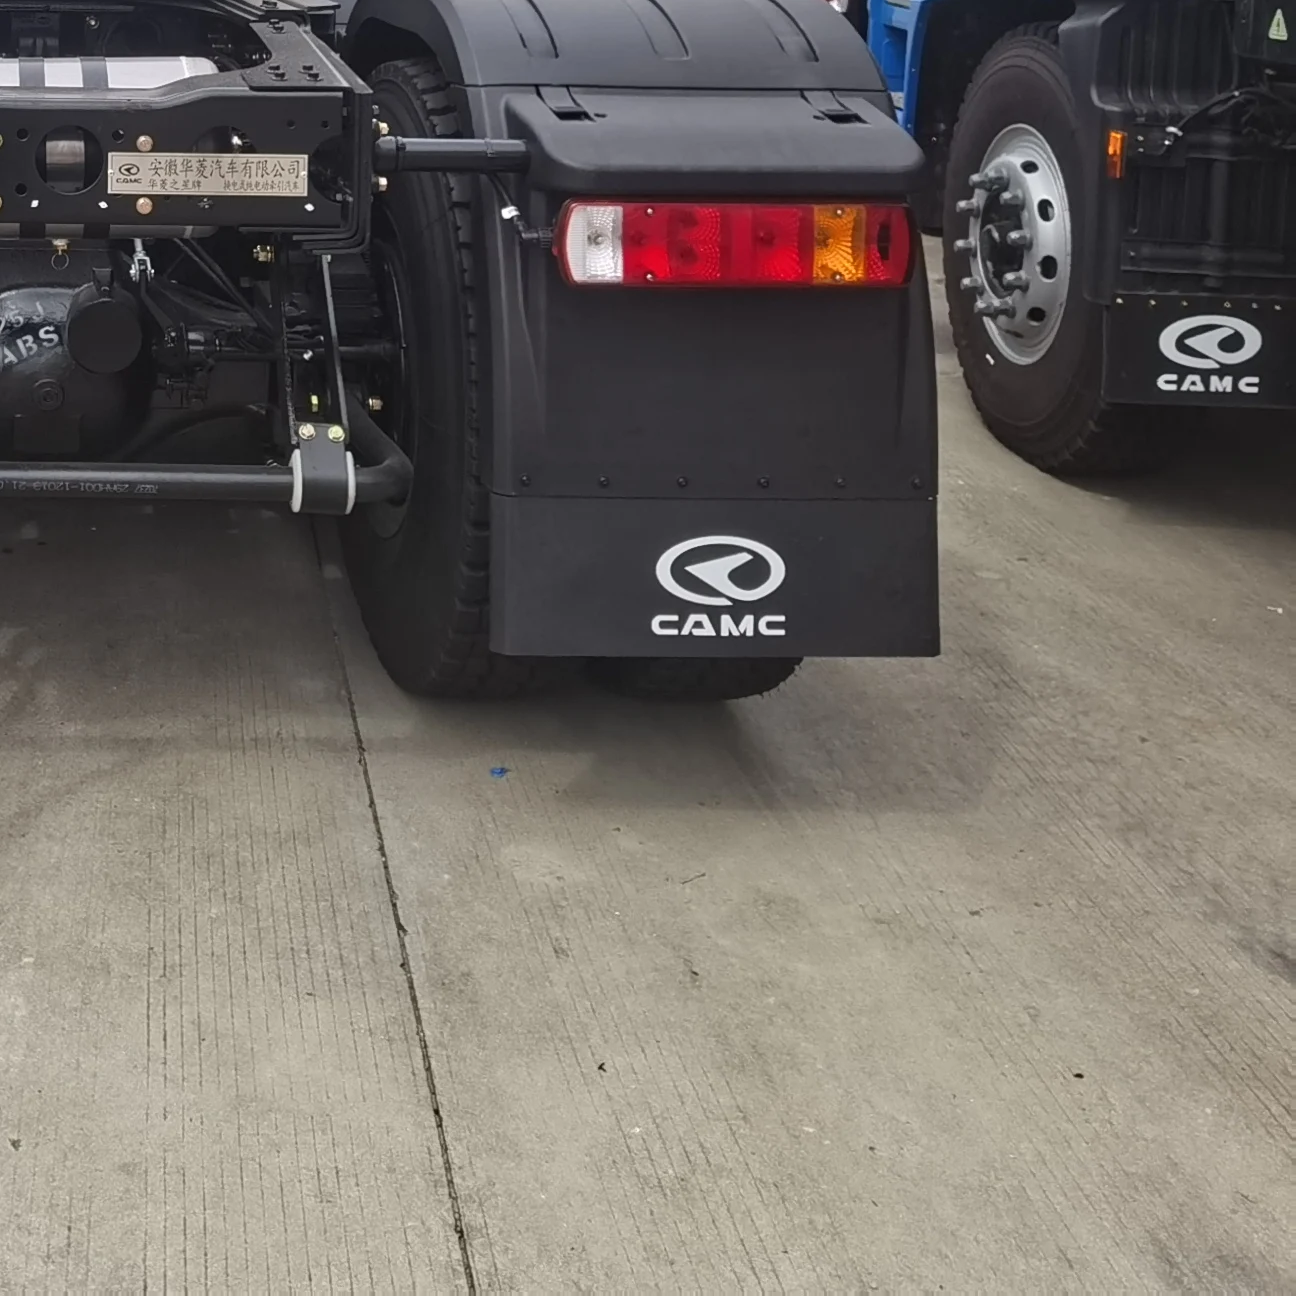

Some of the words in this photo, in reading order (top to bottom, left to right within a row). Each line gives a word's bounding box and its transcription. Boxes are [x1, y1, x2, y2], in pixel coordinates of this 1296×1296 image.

[148, 158, 301, 179] 安徽华菱汽车有限公司
[147, 178, 202, 191] 华菱之星牌
[1156, 373, 1260, 394] CAMC
[651, 613, 786, 637] CAMC
